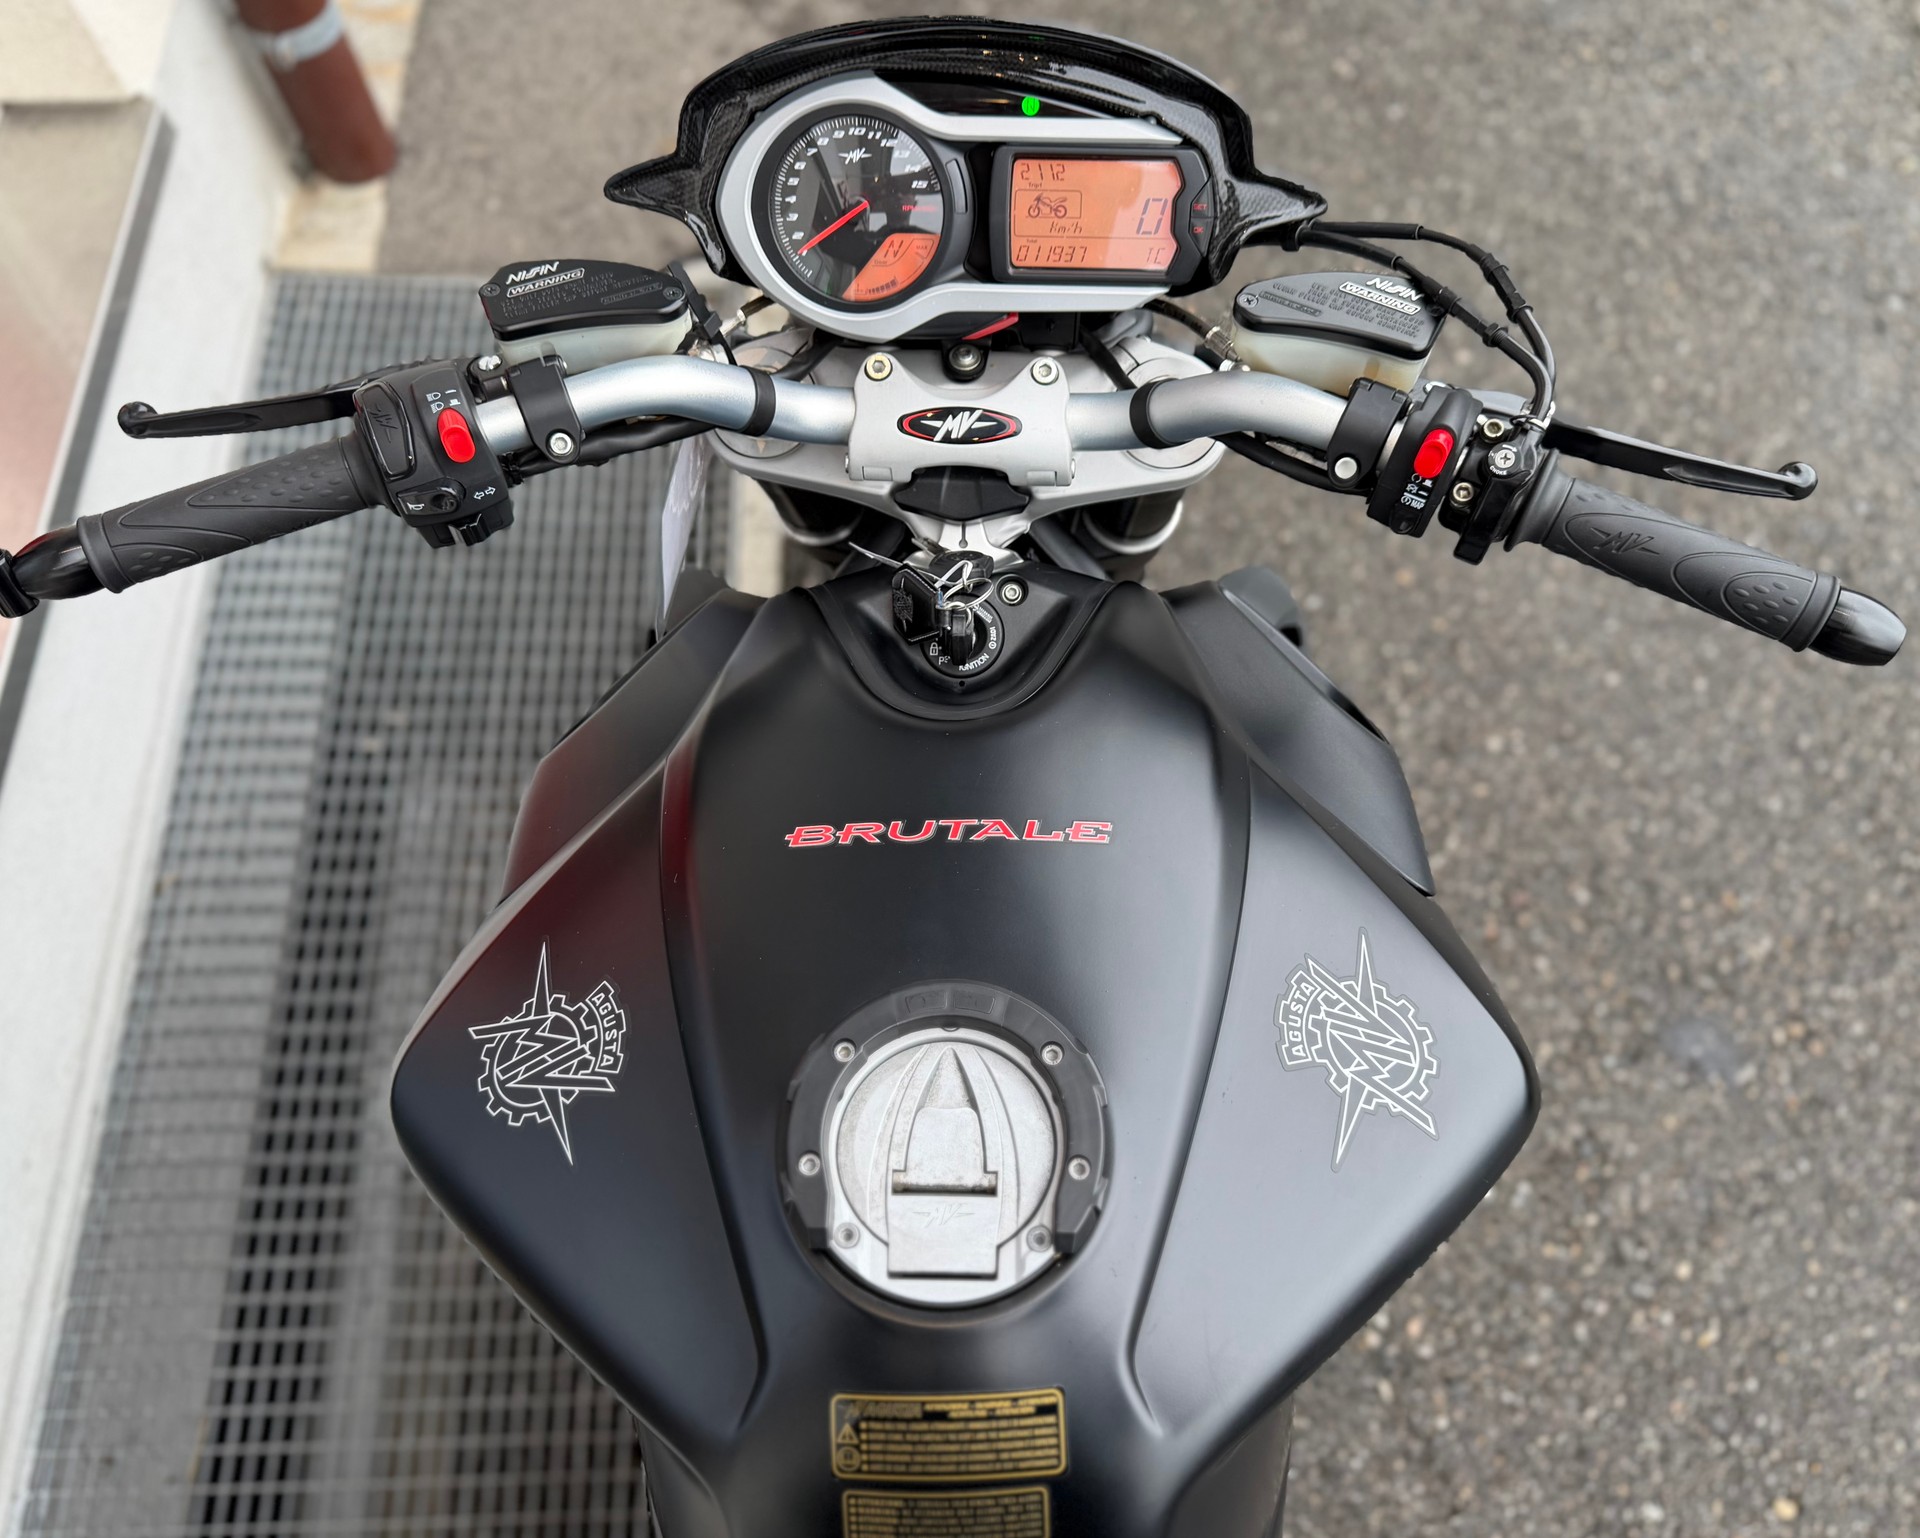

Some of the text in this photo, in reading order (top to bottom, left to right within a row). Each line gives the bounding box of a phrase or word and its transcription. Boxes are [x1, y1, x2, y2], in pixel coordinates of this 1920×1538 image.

[832, 130, 845, 138] 9
[848, 127, 866, 136] 10
[867, 131, 881, 139] 11
[880, 138, 897, 147] 12
[806, 148, 818, 156] 7
[794, 161, 806, 170] 6
[904, 164, 921, 173] 14
[787, 177, 799, 186] 5
[911, 180, 928, 189] 15
[785, 196, 797, 204] 4
[786, 213, 799, 221] 3
[1136, 198, 1168, 236] 0
[792, 232, 804, 240] 2
[884, 239, 904, 258] N
[1016, 245, 1088, 263] 011937
[510, 271, 582, 295] WARNING
[1344, 283, 1418, 312] WARNING
[1410, 496, 1425, 510] MAP
[784, 818, 1113, 847] BRUTALE
[1288, 981, 1316, 1057] AGUSTA
[591, 991, 618, 1068] AGUSTA
